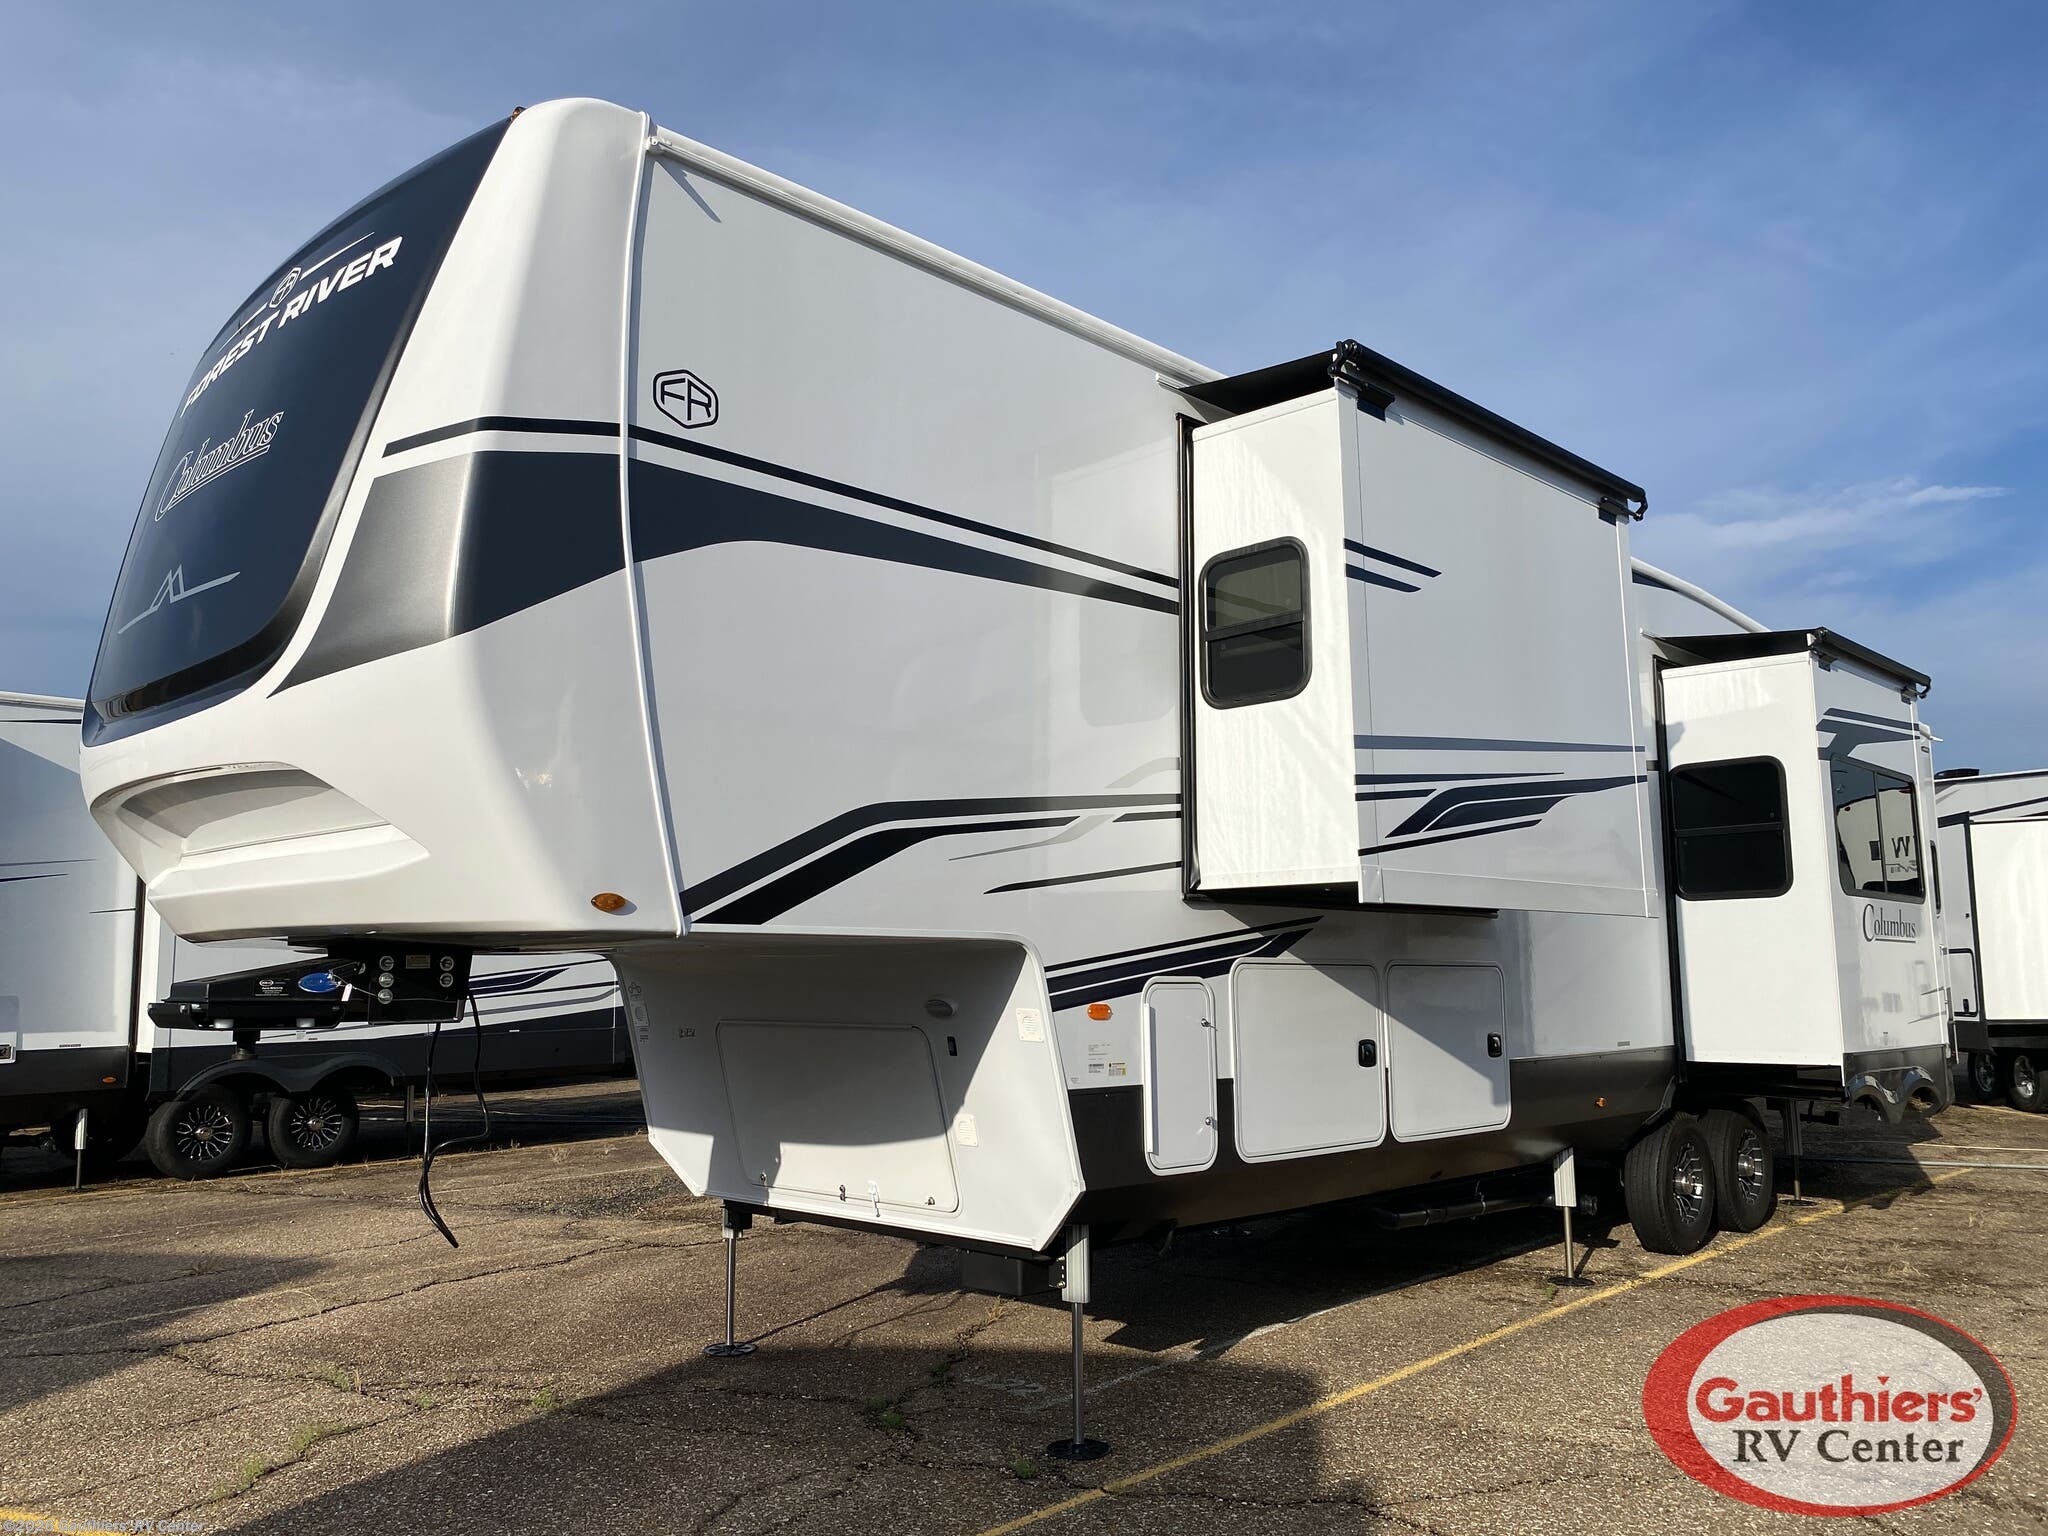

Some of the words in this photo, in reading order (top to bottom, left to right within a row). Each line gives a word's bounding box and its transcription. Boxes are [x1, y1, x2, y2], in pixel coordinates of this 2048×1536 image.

[180, 310, 280, 417] FOREST
[278, 236, 403, 329] RIVER
[656, 373, 716, 425] FR
[155, 408, 284, 521] Columbus
[1863, 904, 1916, 942] Columbus
